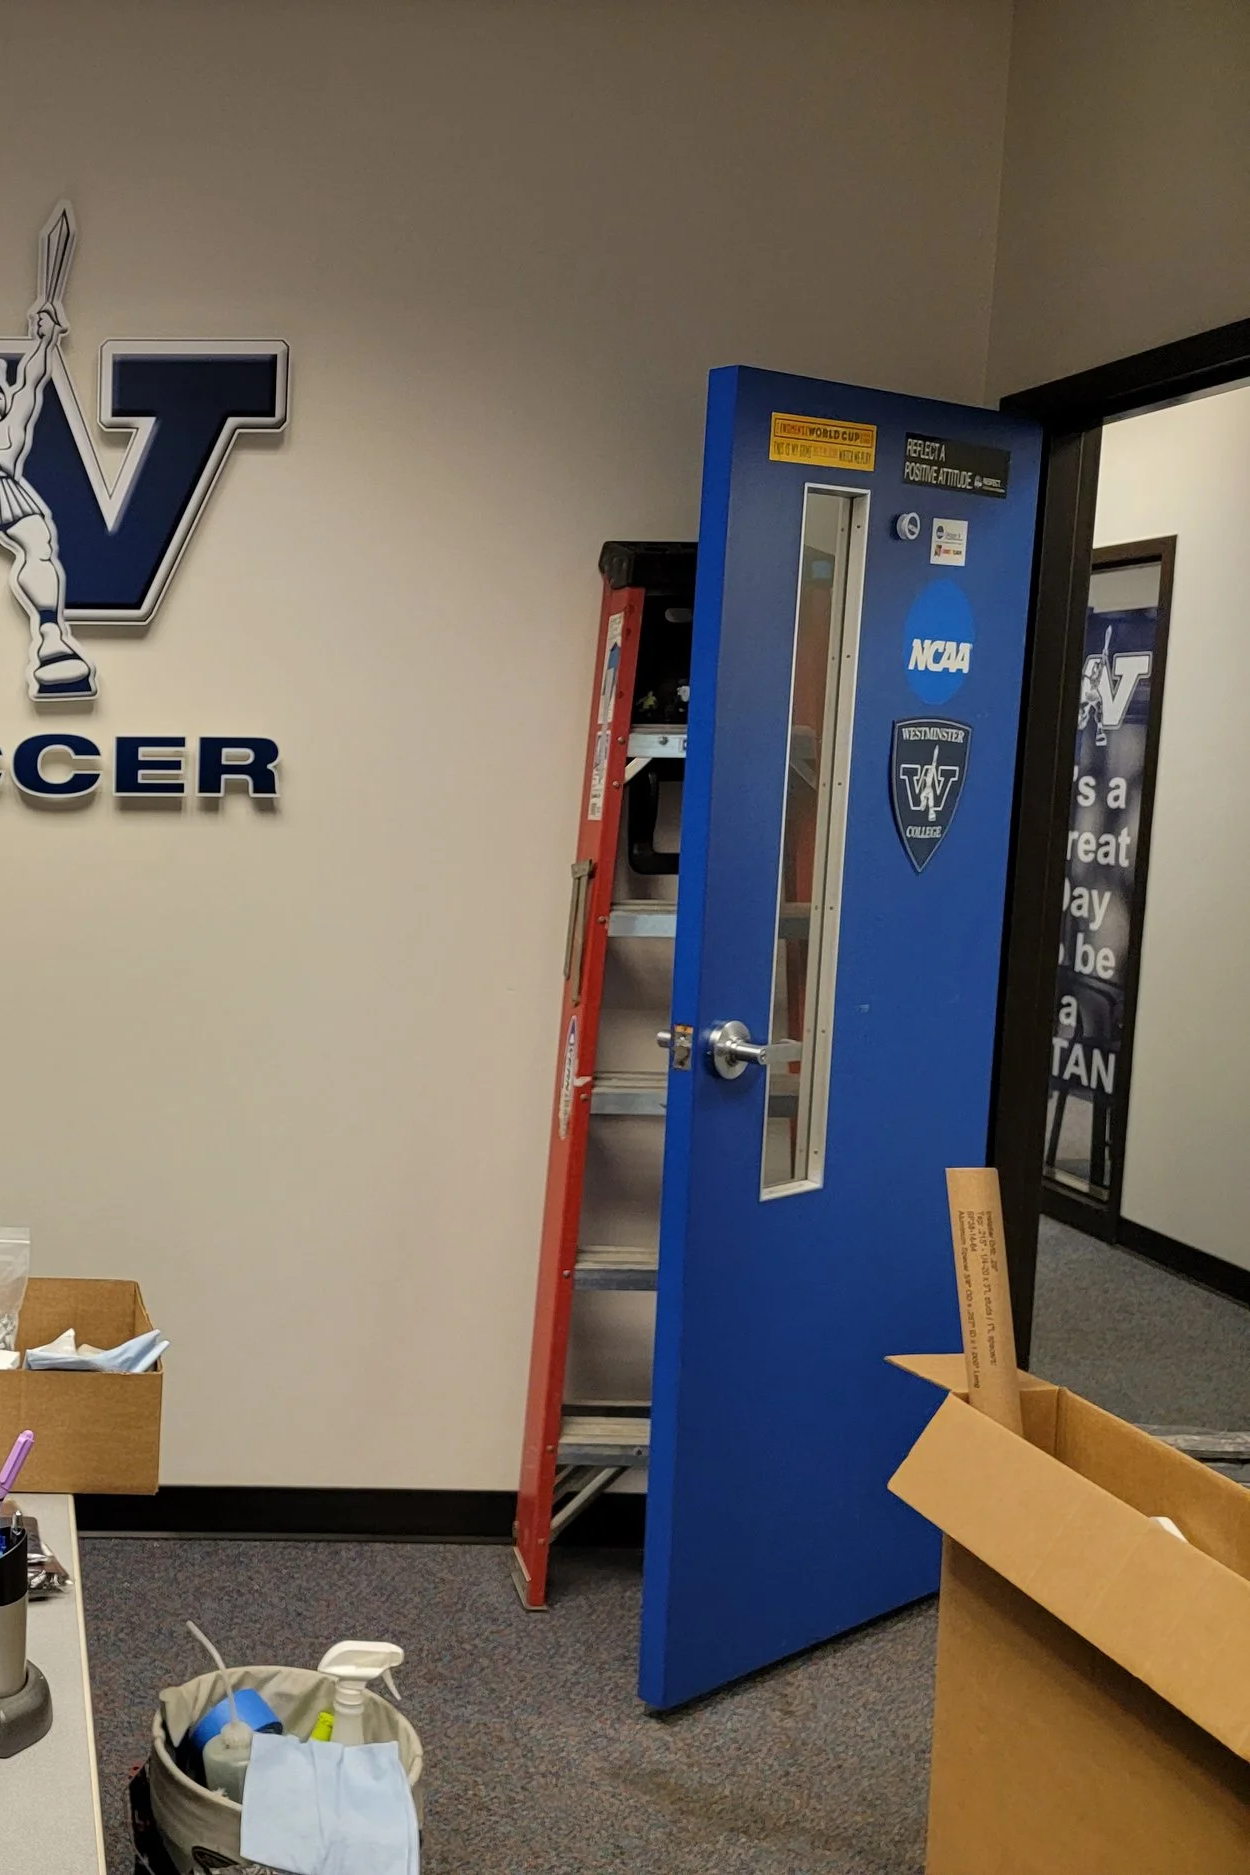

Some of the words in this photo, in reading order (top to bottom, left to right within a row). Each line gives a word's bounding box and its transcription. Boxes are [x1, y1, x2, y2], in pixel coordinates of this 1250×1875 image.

[809, 426, 840, 440] WORLD
[841, 430, 860, 442] CUP
[906, 438, 940, 460] REFLECT
[939, 444, 946, 461] A
[904, 461, 938, 484] POSITIVE
[908, 638, 972, 674] NCAA
[902, 727, 965, 744] WESTMINSTER
[1106, 777, 1128, 809] a
[906, 825, 943, 839] COLLEGE
[1066, 827, 1130, 868] reat
[1074, 933, 1116, 979] be
[1059, 995, 1078, 1028] a
[1052, 1037, 1116, 1095] TAN
